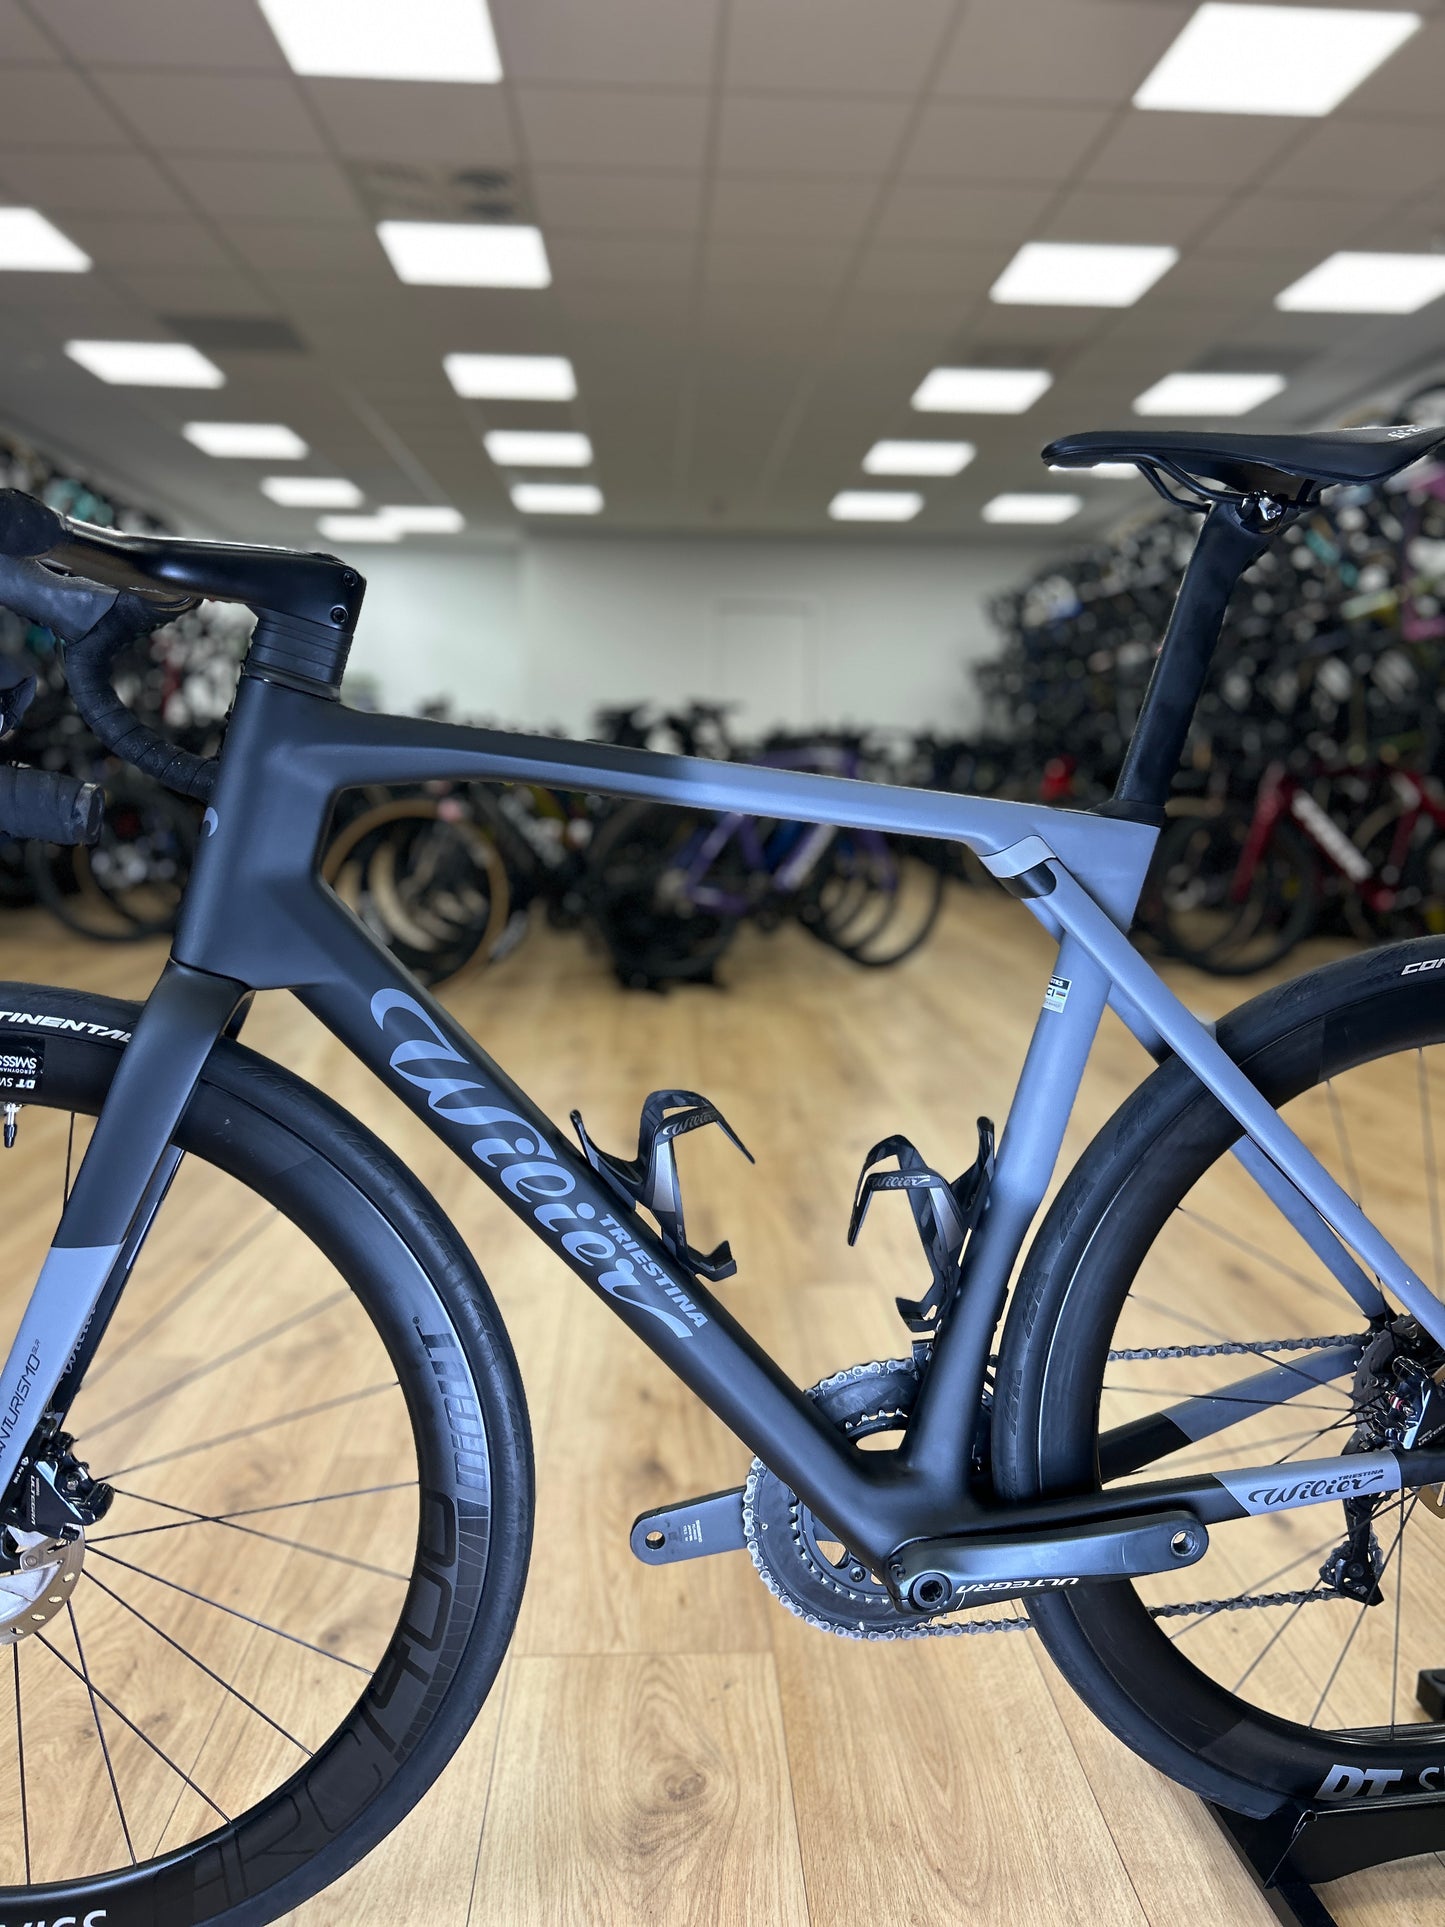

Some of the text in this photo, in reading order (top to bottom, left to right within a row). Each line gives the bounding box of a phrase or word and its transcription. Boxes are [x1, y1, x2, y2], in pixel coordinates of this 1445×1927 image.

[15, 1079, 36, 1089] DT
[370, 987, 694, 1339] Wilier
[599, 1213, 708, 1329] TRIESTINA
[1247, 1474, 1385, 1506] Wilier
[1338, 1468, 1384, 1481] TRIESTINA
[955, 1577, 1080, 1594] ULTEGRA
[1313, 1764, 1404, 1801] DT
